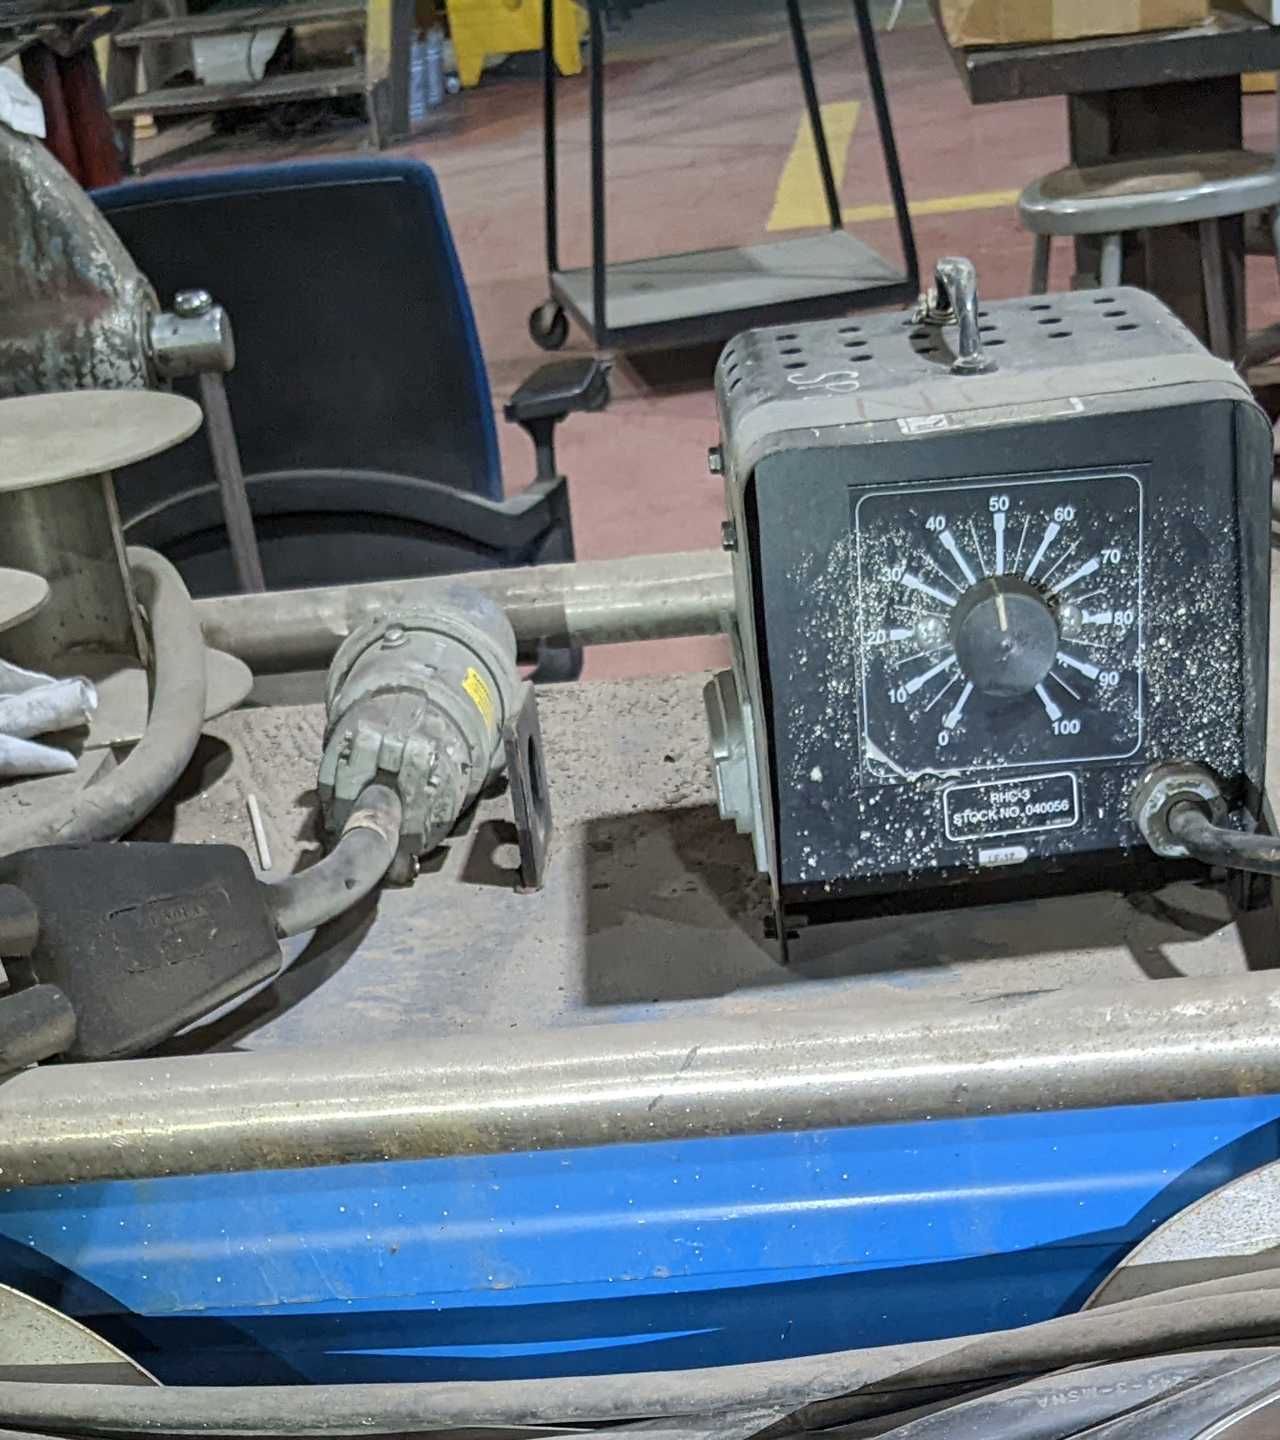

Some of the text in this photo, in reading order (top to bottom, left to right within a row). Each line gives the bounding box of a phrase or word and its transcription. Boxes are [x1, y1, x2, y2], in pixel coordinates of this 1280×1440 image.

[989, 496, 1010, 511] 50
[1054, 507, 1074, 521] 60
[926, 516, 946, 531] 40
[1101, 549, 1121, 564] 70
[882, 567, 902, 581] 30
[1114, 611, 1134, 626] 80
[867, 629, 886, 644] 20
[1099, 671, 1119, 686] 90
[888, 688, 907, 703] 10
[1051, 720, 1080, 735] 100
[938, 731, 949, 746] 0
[990, 789, 1031, 804] RHC-3
[953, 809, 998, 826] STOCK
[1025, 800, 1069, 816] 040056
